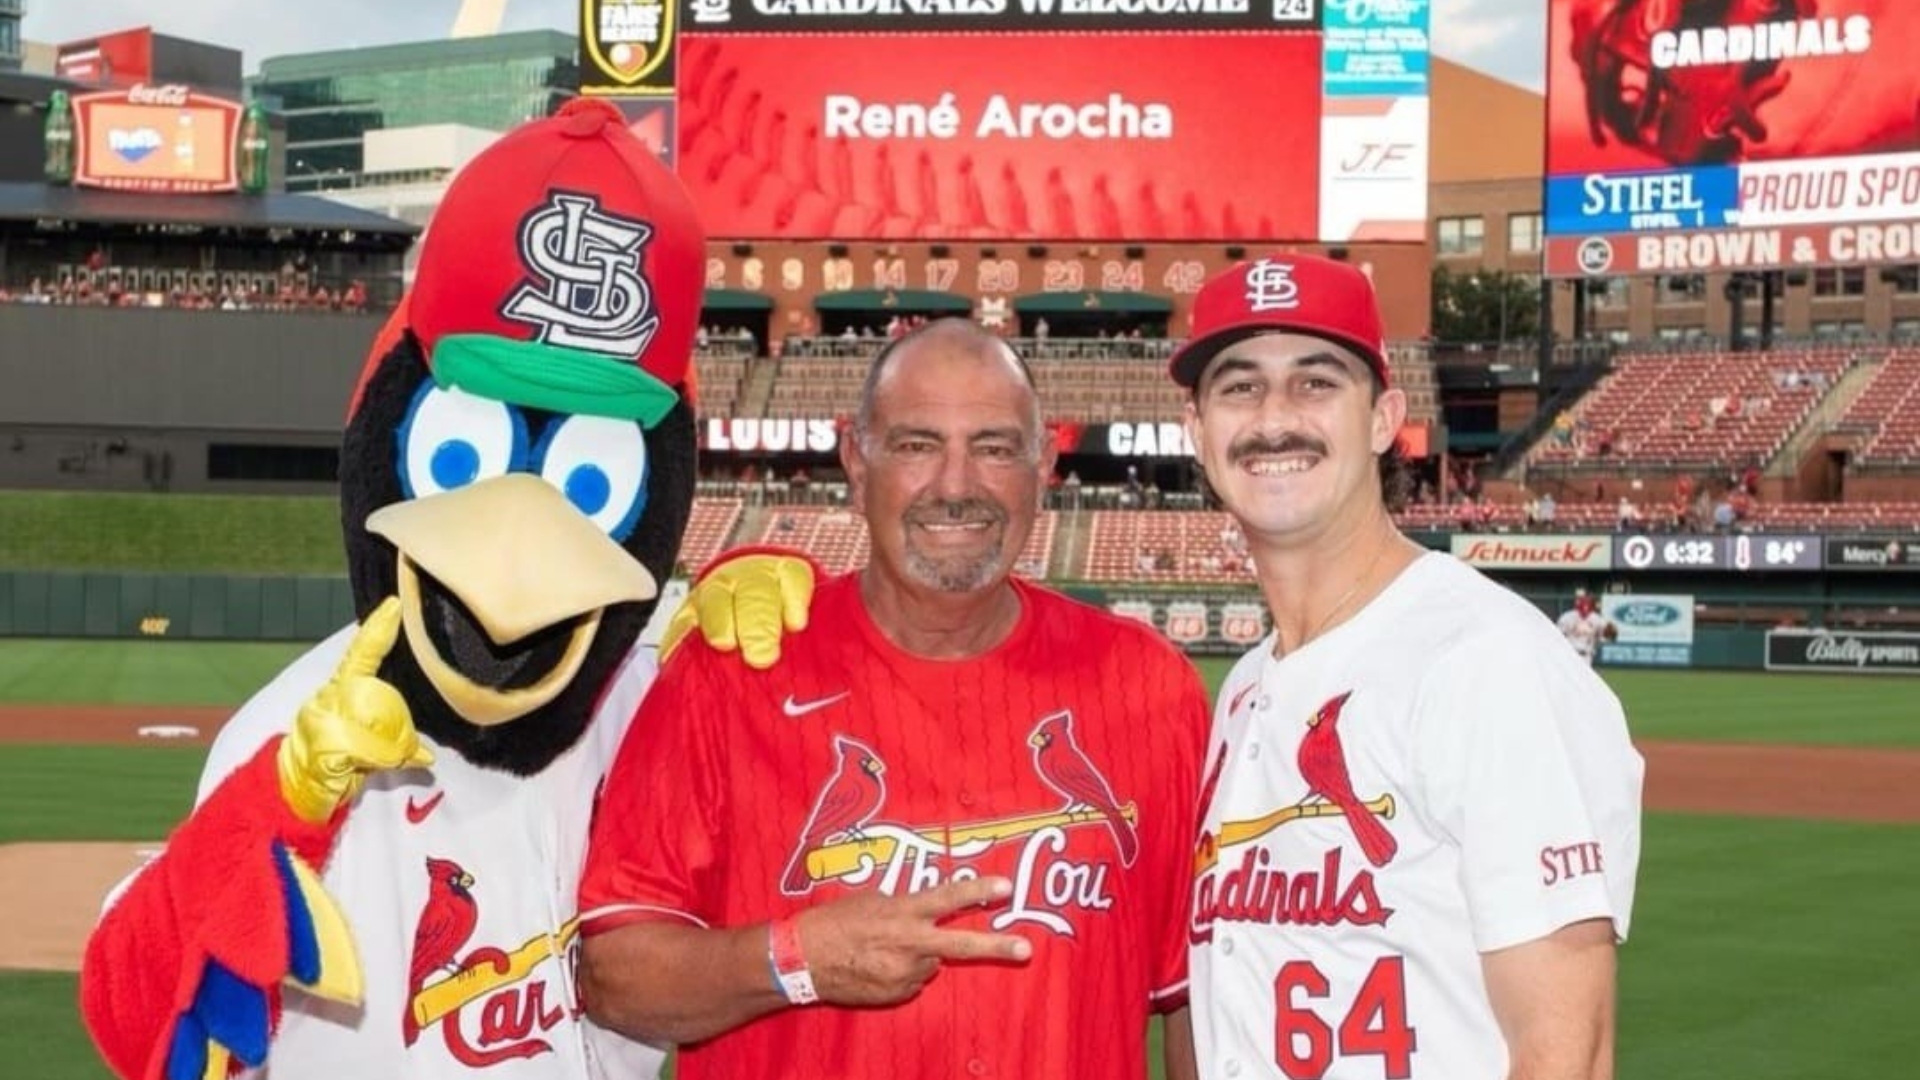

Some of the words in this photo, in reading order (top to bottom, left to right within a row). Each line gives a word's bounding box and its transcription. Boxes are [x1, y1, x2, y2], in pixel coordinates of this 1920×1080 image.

[1650, 15, 1871, 68] CARDINALS
[824, 92, 960, 138] René
[975, 93, 1173, 139] Arocha
[1582, 173, 1704, 215] STIFEL
[1741, 170, 1848, 212] PROUD
[1636, 230, 1781, 270] BROWN
[1791, 235, 1817, 264] &
[705, 257, 726, 291] 2
[781, 257, 804, 291] 9
[872, 258, 907, 292] 14
[924, 258, 960, 292] 17
[1042, 259, 1084, 293] 23
[1101, 259, 1145, 292] 24
[708, 418, 837, 451] LOUIS
[1460, 541, 1602, 563] Schnucks
[1663, 540, 1716, 565] 6:32
[991, 825, 1113, 936] Lou
[1274, 955, 1417, 1080] 64
